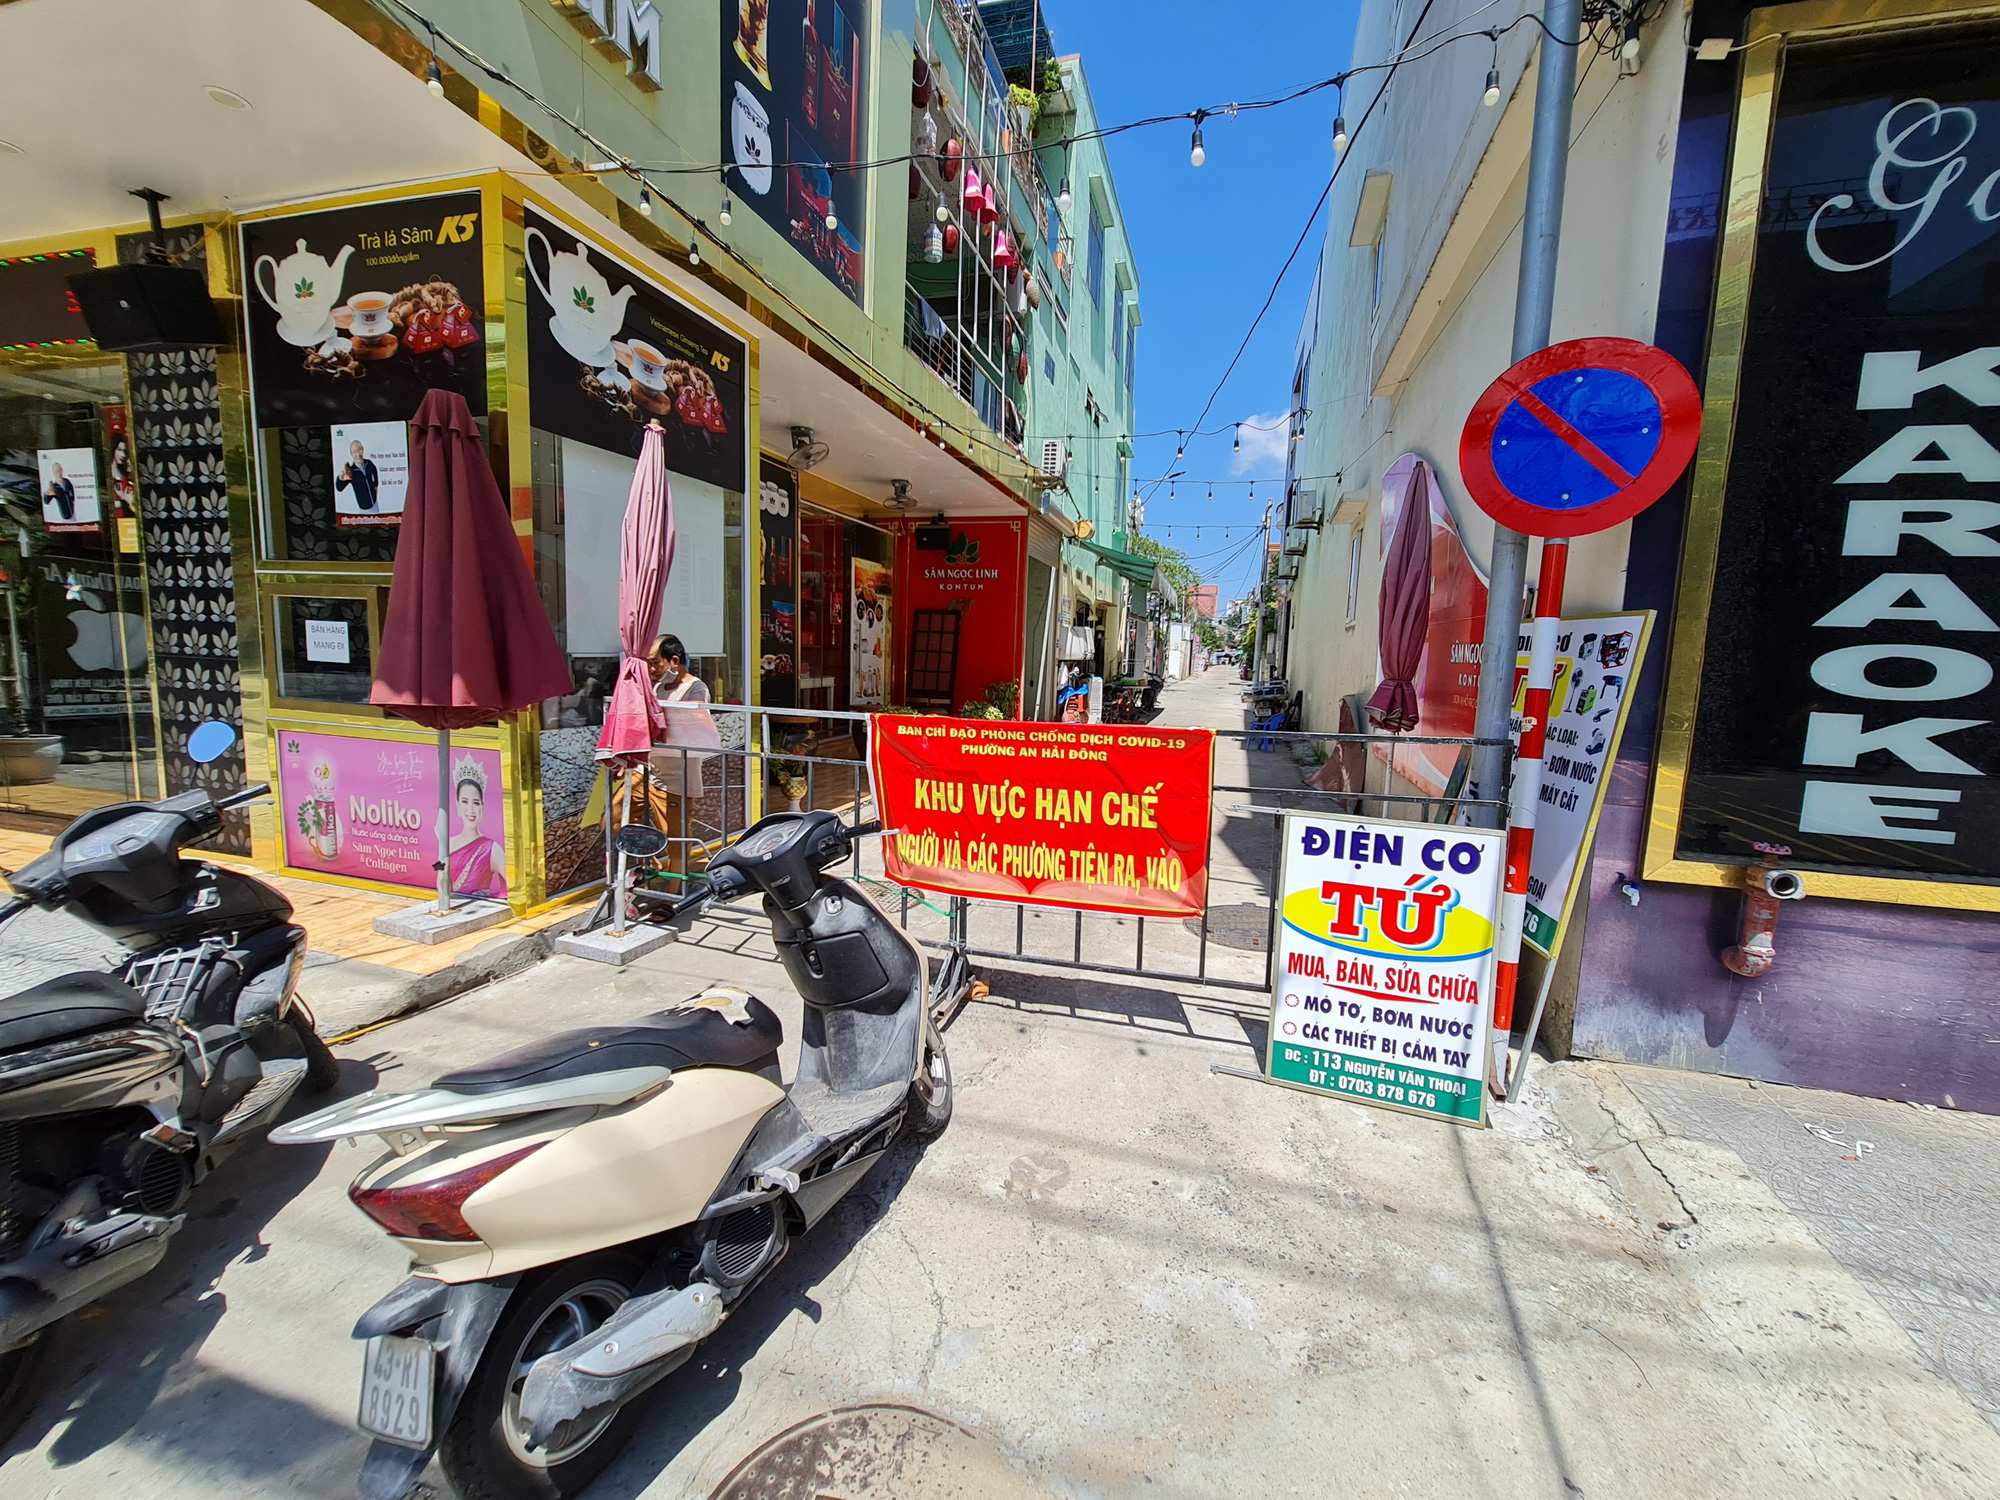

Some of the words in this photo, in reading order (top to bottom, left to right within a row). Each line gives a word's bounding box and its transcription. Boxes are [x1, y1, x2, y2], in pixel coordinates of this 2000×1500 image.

[358, 232, 381, 250] Trà
[384, 229, 397, 247] lá
[401, 226, 434, 245] Sâm
[436, 212, 479, 245] K5
[710, 350, 731, 372] K5
[924, 566, 945, 579] SÂM
[947, 568, 974, 581] NGỌC
[975, 569, 998, 579] LINH
[939, 583, 984, 591] KONTUM
[1798, 346, 2000, 845] KARAOKE
[311, 624, 325, 634] BÁN
[326, 625, 346, 635] HÀNG
[313, 640, 335, 650] MANG
[897, 725, 923, 737] BAN
[925, 724, 946, 738] CHỈ
[949, 728, 977, 740] ĐẠO
[980, 727, 1026, 742] PHÒNG
[1029, 728, 1077, 744] CHỐNG
[1080, 733, 1113, 746] DỊCH
[1117, 735, 1186, 749] COVID-19
[961, 743, 1016, 758] PHƯỜNG
[1018, 747, 1038, 758] AN
[1041, 745, 1065, 760] HẢI
[1068, 747, 1108, 762] ĐÔNG
[1548, 755, 1571, 777] BƠM
[1569, 760, 1597, 785] NƯỚC
[349, 794, 422, 830] Noliko
[914, 778, 964, 814] KHU
[972, 778, 1026, 824] VỰC
[1035, 788, 1093, 829] HẠN
[1101, 782, 1165, 829] CHẾ
[1539, 783, 1561, 806] MÁY
[351, 827, 369, 837] Nước
[369, 830, 386, 842] uống
[409, 835, 419, 844] da
[352, 841, 372, 854] Sâm
[374, 844, 397, 859] Ngọc
[398, 848, 421, 861] Linh
[1301, 824, 1404, 871] ĐIỆN
[1421, 838, 1486, 875] CƠ
[365, 856, 408, 874] Collagen
[896, 827, 940, 868] NGƯỜI
[943, 830, 962, 871] VÀ
[966, 833, 998, 875] CÁC
[1002, 839, 1066, 882] PHƯƠNG
[1069, 842, 1110, 891] TIỆN
[1113, 853, 1141, 896] RA,
[1146, 848, 1182, 893] VÀO
[1320, 873, 1456, 949] TỨ
[1287, 952, 1330, 983] MUA,
[1336, 957, 1379, 991] BÁN,
[1384, 961, 1422, 996] SỬA
[1428, 973, 1480, 1005] CHỮA
[1303, 995, 1333, 1014] MÔ
[1338, 1001, 1367, 1024] TƠ,
[1372, 1006, 1414, 1029] BƠM
[1420, 1015, 1474, 1040] NƯỚC
[1302, 1021, 1330, 1042] CÁC
[1334, 1028, 1377, 1049] THIẾT
[1381, 1037, 1397, 1059] BỊ
[1402, 1038, 1437, 1063] CẦM
[1443, 1049, 1472, 1069] TAY
[1284, 1048, 1302, 1063] ĐC
[1312, 1050, 1342, 1071] 113
[1344, 1061, 1396, 1082] NGUYỄN
[1398, 1069, 1426, 1088] VĂN
[1428, 1076, 1467, 1097] THOẠI
[1309, 1069, 1328, 1085] ĐT
[1338, 1075, 1374, 1095] 0703
[1376, 1082, 1405, 1102] 878
[1407, 1088, 1437, 1108] 676
[368, 1385, 420, 1438] 8929
